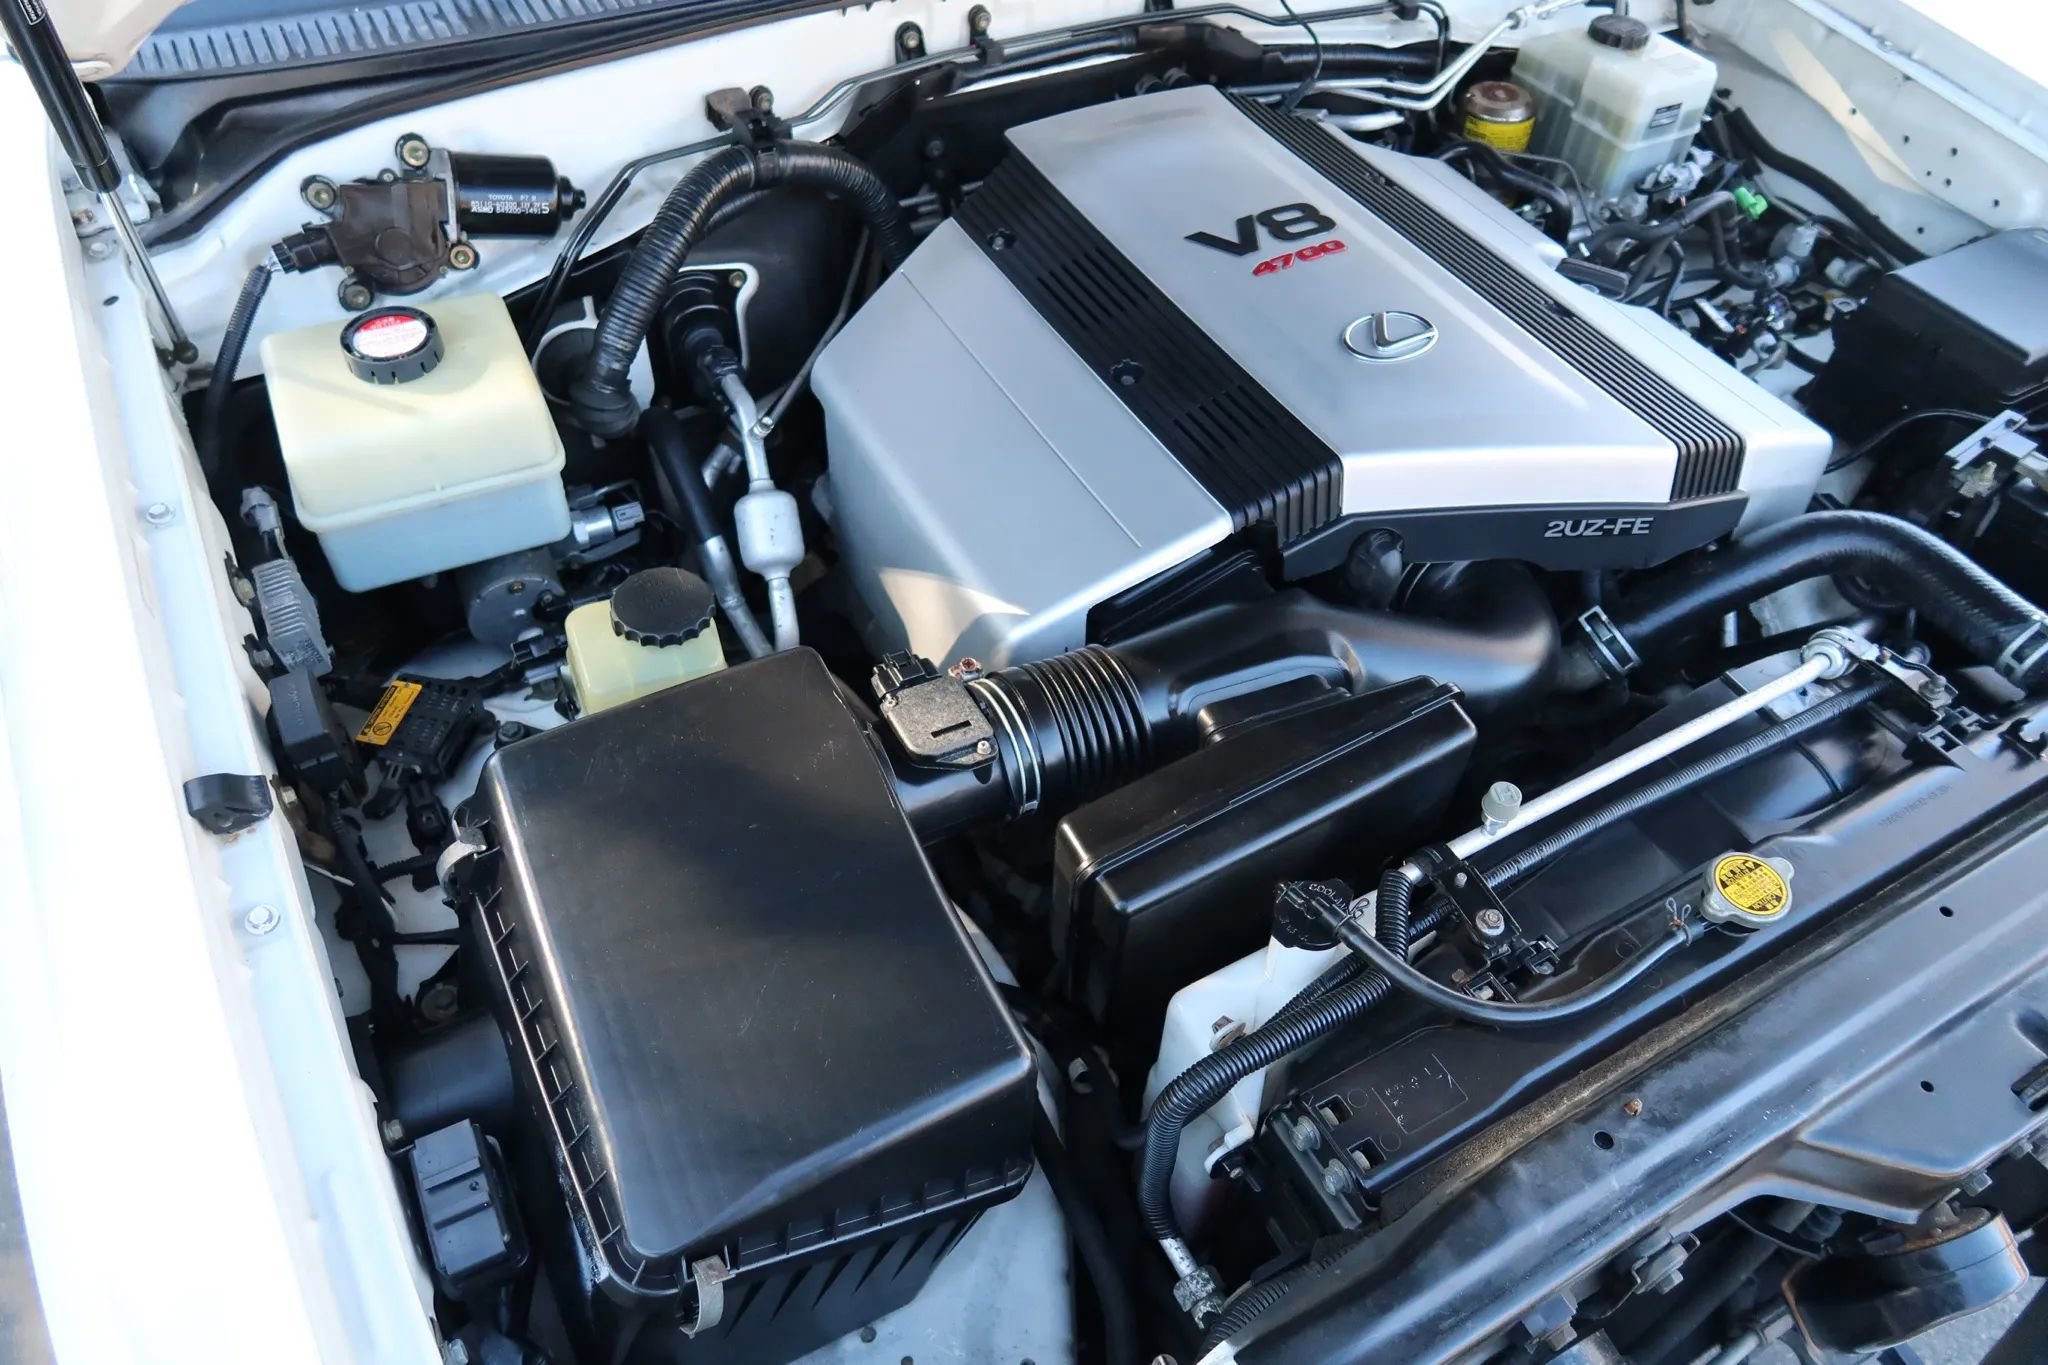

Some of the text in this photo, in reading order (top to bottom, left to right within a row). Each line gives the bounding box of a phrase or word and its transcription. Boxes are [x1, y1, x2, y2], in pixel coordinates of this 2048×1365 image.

[1184, 202, 1337, 256] V8
[1252, 240, 1347, 276] 4700
[1544, 517, 1654, 537] 2UZ-FE
